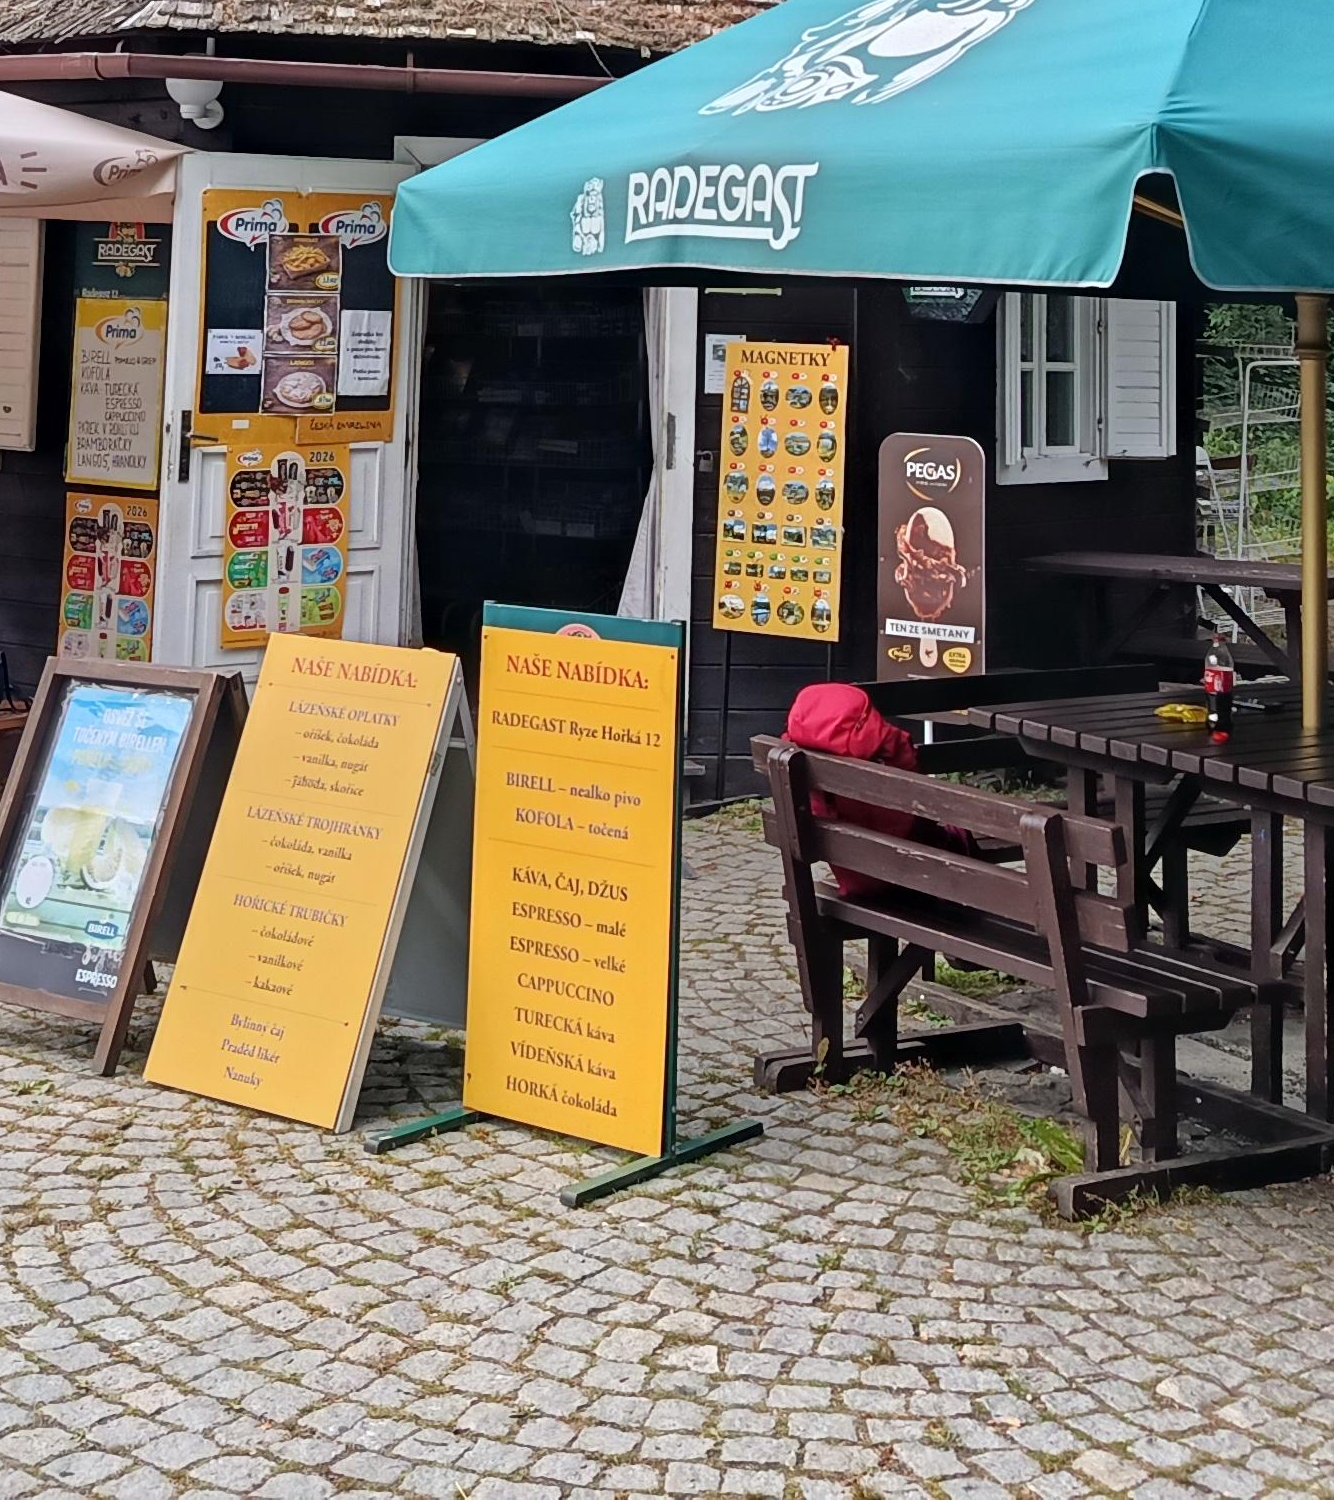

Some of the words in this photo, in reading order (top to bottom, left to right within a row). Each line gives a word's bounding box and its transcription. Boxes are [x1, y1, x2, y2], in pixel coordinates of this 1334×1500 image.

[108, 164, 143, 181] Prim
[625, 162, 819, 250] RADEGAST
[235, 217, 277, 233] Prima
[336, 219, 375, 234] Prima
[97, 243, 157, 262] RADEGAST
[106, 324, 137, 339] Prima
[741, 350, 830, 367] MAGNETKY
[81, 366, 110, 380] KOFOLA
[105, 397, 142, 409] ESPRESSO
[104, 411, 146, 422] CAPPUCCINO
[309, 451, 335, 462] 2026
[906, 461, 956, 480] PEGAS
[126, 505, 148, 517] 2026
[890, 622, 907, 633] TEN
[908, 625, 919, 635] ZE
[921, 626, 970, 639] SMETANY
[291, 656, 334, 677] NAŠE
[338, 663, 419, 688] NABÍDKA:
[506, 653, 552, 678] NAŠE
[556, 661, 649, 690] NABÍDKA:
[289, 700, 347, 718] LÁZEŇSKÉ
[348, 711, 400, 726] OPLATKY
[303, 727, 334, 744] oříšek,
[336, 733, 379, 749] čokoláda
[492, 710, 567, 734] RADEGAST
[569, 720, 599, 741] Ryze
[602, 725, 641, 745] Hořká
[646, 733, 661, 747] 12
[302, 753, 338, 769] vanilka,
[340, 760, 368, 774] nugát
[329, 783, 364, 796] skořice
[506, 771, 555, 793] BIRELL
[570, 784, 611, 801] nealko
[614, 791, 641, 807] pivo
[247, 806, 305, 827] LÁZEŇSKÉ
[307, 816, 383, 840] TROJHRÁNKY
[515, 807, 574, 830] KOFOLA
[588, 822, 629, 840] točená
[270, 835, 315, 854] čokoláda,
[318, 847, 352, 860] vanilka
[307, 871, 336, 885] nugát
[512, 866, 551, 890] KÁVA,
[555, 872, 584, 896] ČAJ,
[588, 880, 628, 902] DŽUS
[233, 893, 288, 915] HOŘICKÉ
[289, 905, 348, 927] TRUBIČKY
[512, 901, 582, 928] ESPRESSO
[596, 921, 626, 937] malé
[87, 925, 115, 937] BIRELL
[259, 925, 315, 947] čokoládové
[257, 954, 304, 971] vanilkové
[510, 936, 579, 963] ESPRESSO
[594, 955, 626, 973] velké
[75, 969, 118, 988] ESPRESSO
[252, 976, 293, 996] kakaové
[517, 972, 615, 1007] CAPPUCCINO
[230, 1013, 268, 1036] Bylinný
[270, 1024, 285, 1041] čaj
[514, 1006, 583, 1036] TURECKÁ
[586, 1022, 615, 1044] káva
[221, 1039, 256, 1058] Praděd
[257, 1046, 280, 1064] likér
[510, 1040, 584, 1073] VÍDEŇSKÁ
[587, 1059, 616, 1080] káva
[224, 1066, 262, 1090] Nanuky
[506, 1075, 558, 1103] HORKÁ
[561, 1090, 617, 1117] čokoláda
